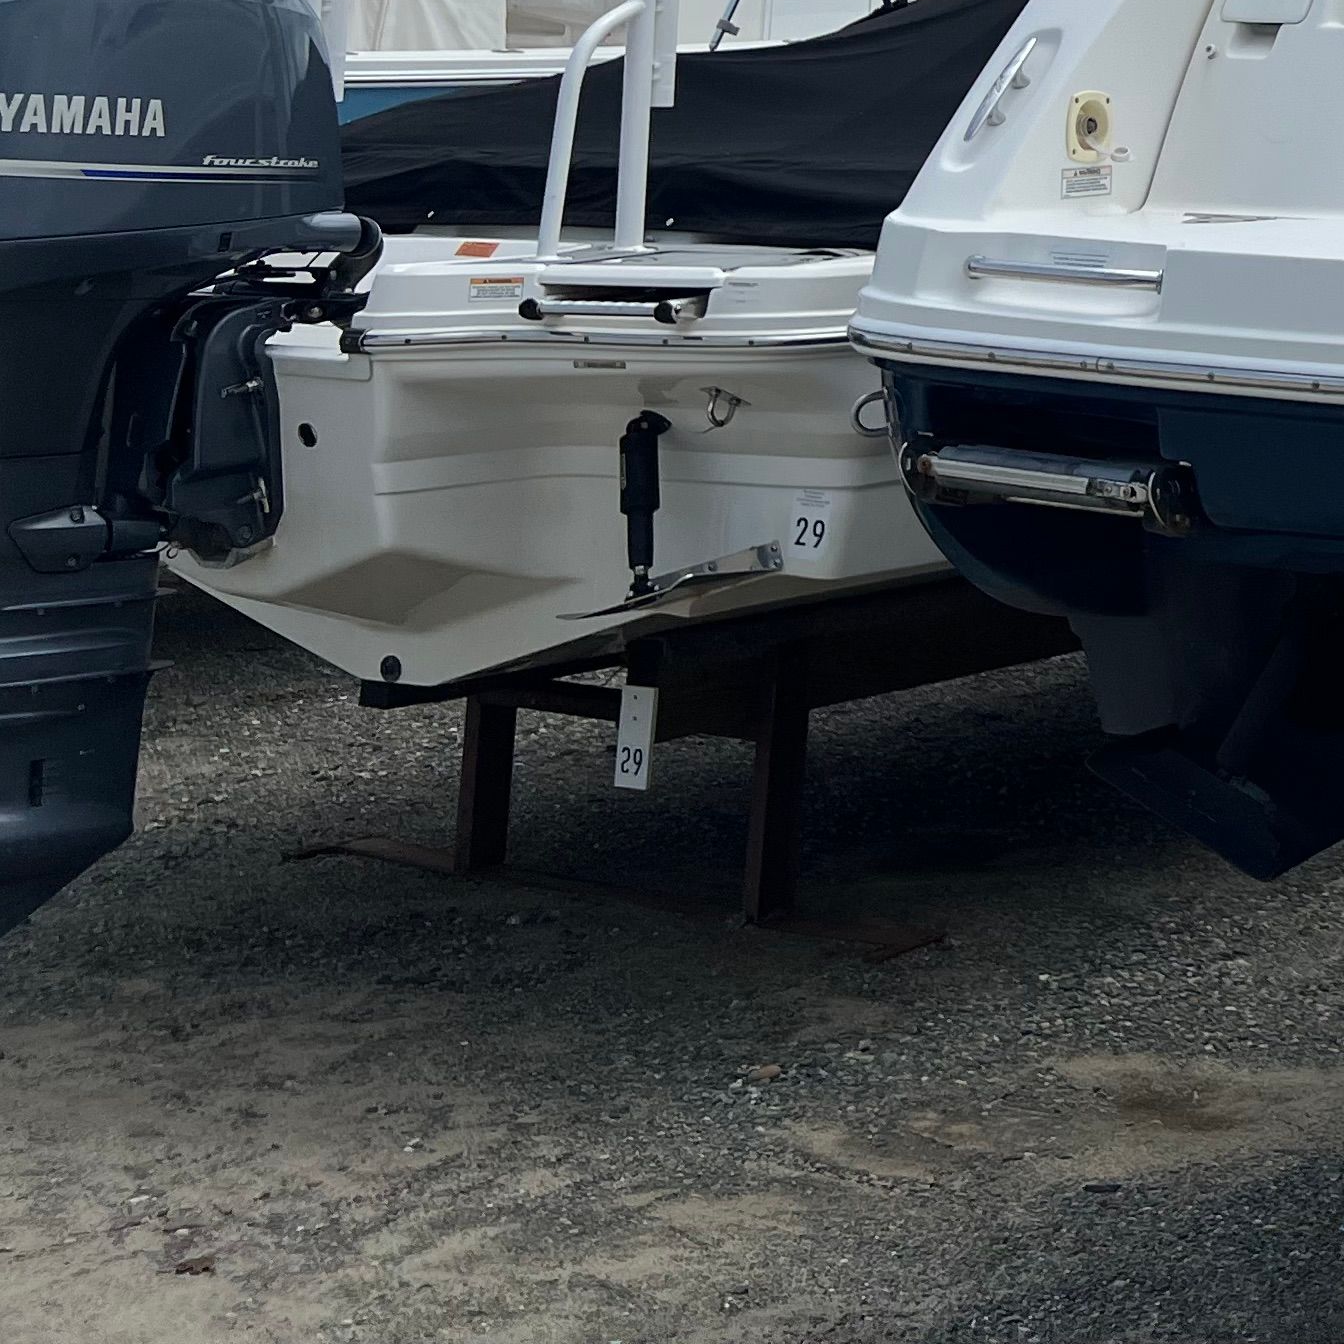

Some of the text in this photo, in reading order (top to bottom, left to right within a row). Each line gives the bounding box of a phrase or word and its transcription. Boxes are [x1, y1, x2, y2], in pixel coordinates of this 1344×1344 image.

[0, 93, 166, 137] YAMAHA
[794, 517, 826, 549] 29
[620, 746, 643, 776] 29
